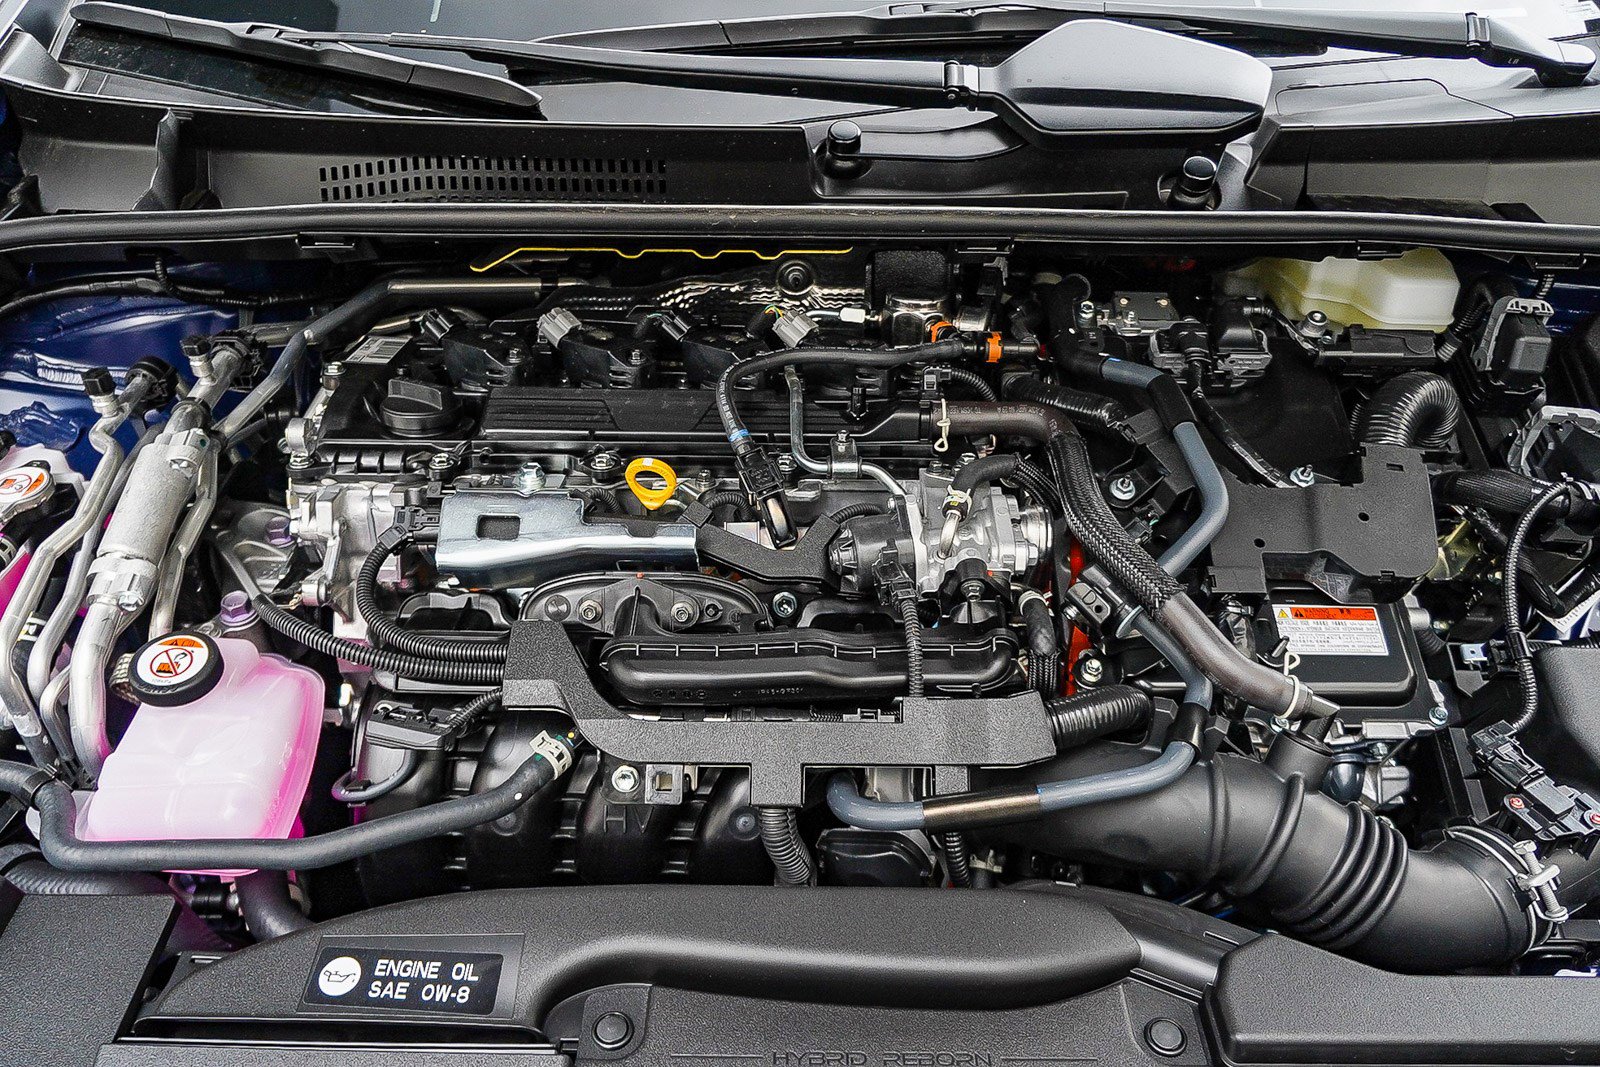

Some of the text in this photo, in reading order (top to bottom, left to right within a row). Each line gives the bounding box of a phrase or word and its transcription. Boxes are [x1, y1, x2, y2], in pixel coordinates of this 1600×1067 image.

[604, 804, 655, 834] HV
[374, 959, 479, 982] ENGINE OIL
[368, 981, 471, 1004] SAE 0W-8
[773, 1049, 992, 1066] HYBRID REBORN
